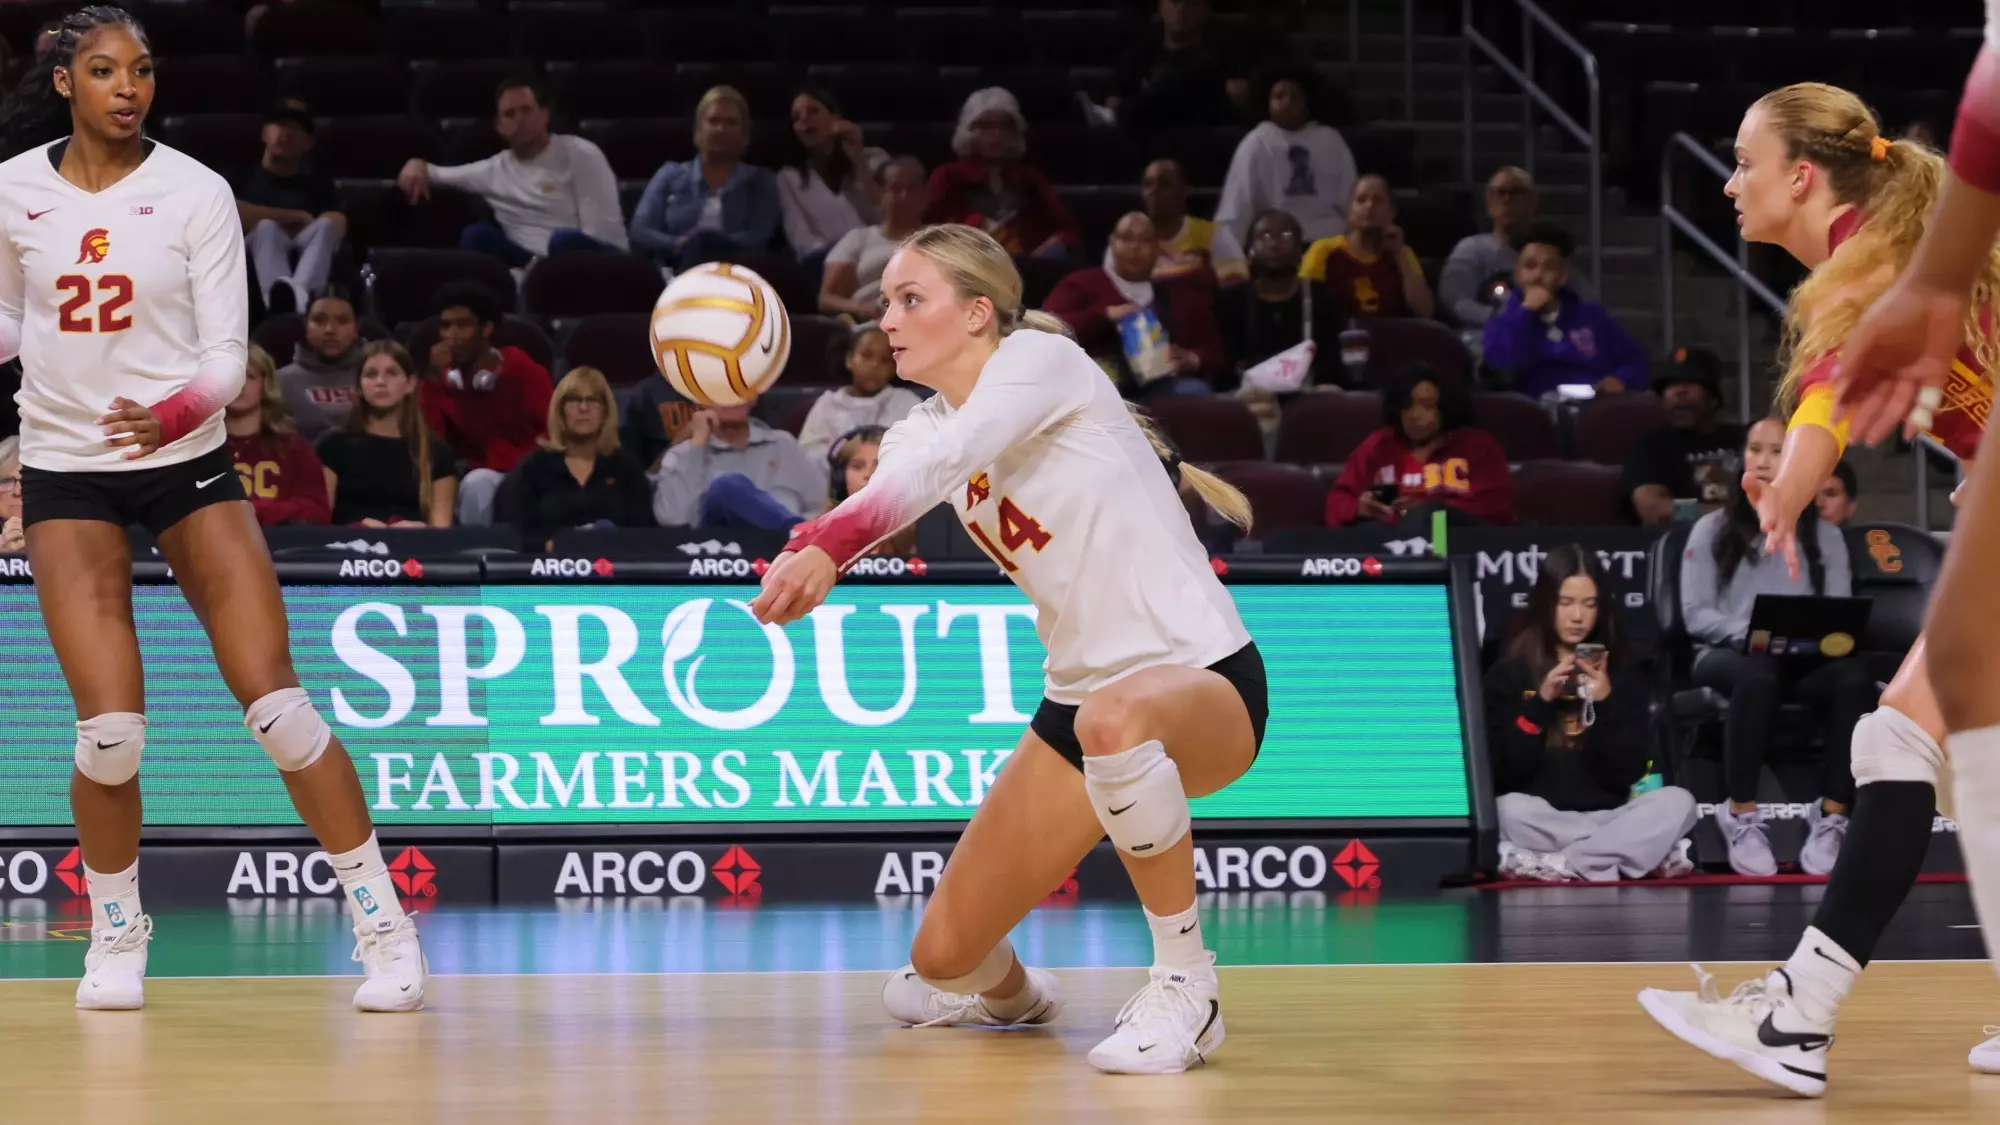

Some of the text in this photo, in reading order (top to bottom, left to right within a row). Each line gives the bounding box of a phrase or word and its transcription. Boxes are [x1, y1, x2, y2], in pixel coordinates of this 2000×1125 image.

[56, 274, 134, 333] 22
[967, 494, 1053, 573] 14
[339, 559, 401, 577] ARCO
[530, 558, 592, 576] ARCO
[688, 558, 750, 577] ARCO
[846, 557, 905, 576] ARCO
[1302, 558, 1361, 576] ARCO
[330, 597, 1038, 730] SPROUT
[371, 749, 1017, 811] FARMERS MARK
[226, 851, 338, 894] ARC
[554, 851, 706, 894] ARCO
[874, 851, 944, 893] AR
